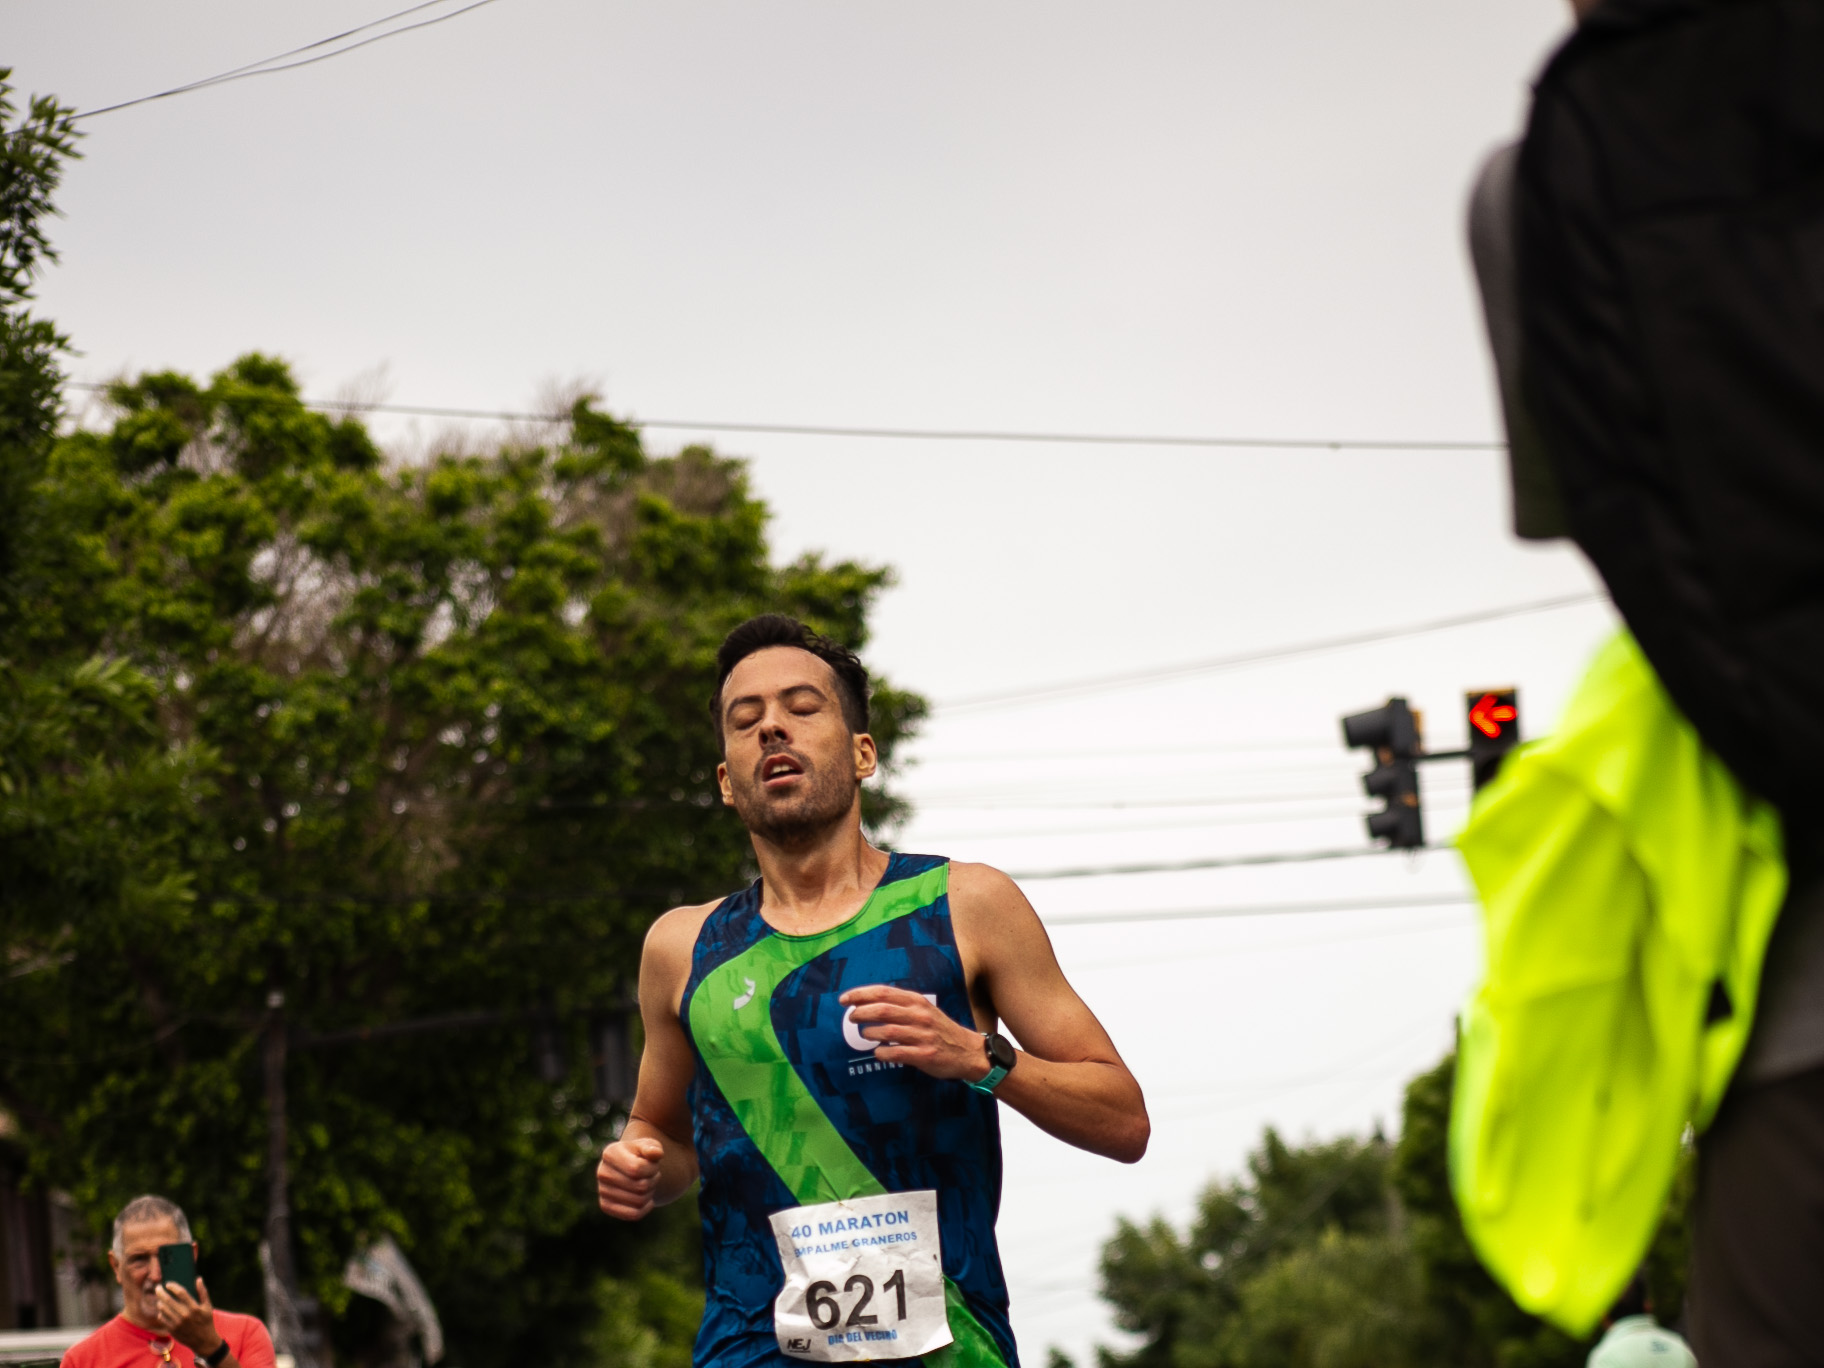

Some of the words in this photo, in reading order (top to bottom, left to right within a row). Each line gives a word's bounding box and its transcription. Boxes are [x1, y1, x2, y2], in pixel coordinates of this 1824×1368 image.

[791, 1225, 812, 1240] 40
[818, 1210, 910, 1236] MARATON
[852, 1231, 918, 1248] GRANEROS
[805, 1268, 907, 1331] 621
[845, 1331, 863, 1343] DEL
